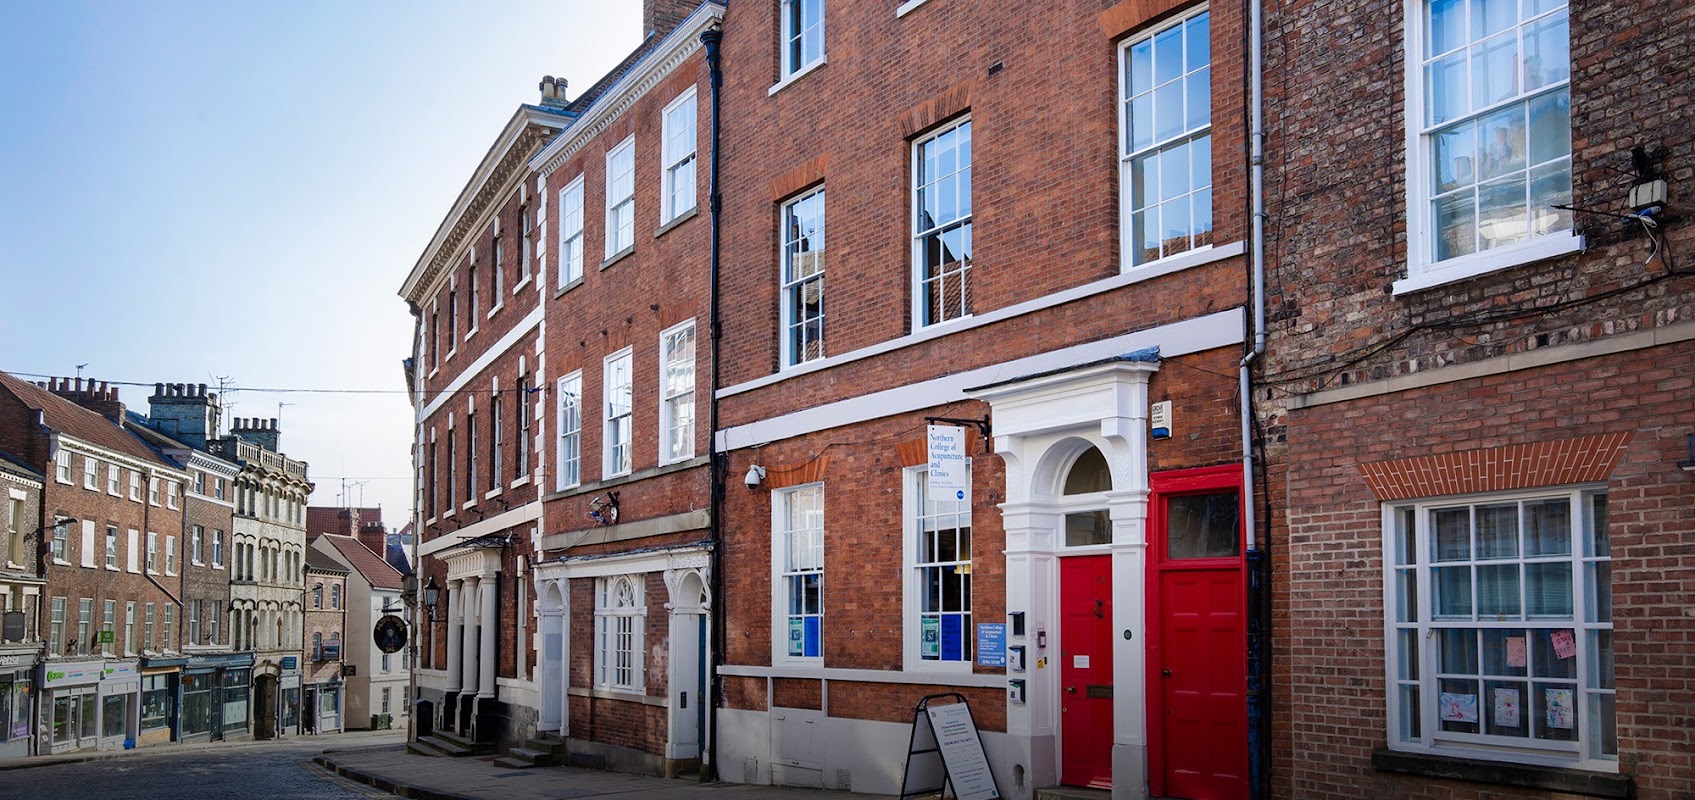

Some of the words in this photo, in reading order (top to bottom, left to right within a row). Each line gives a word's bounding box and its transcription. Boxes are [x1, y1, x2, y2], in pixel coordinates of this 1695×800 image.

[930, 433, 954, 441] Northern
[930, 443, 950, 452] College
[951, 443, 957, 451] of
[930, 452, 963, 461] Acupuncture
[930, 470, 949, 478] Clinics
